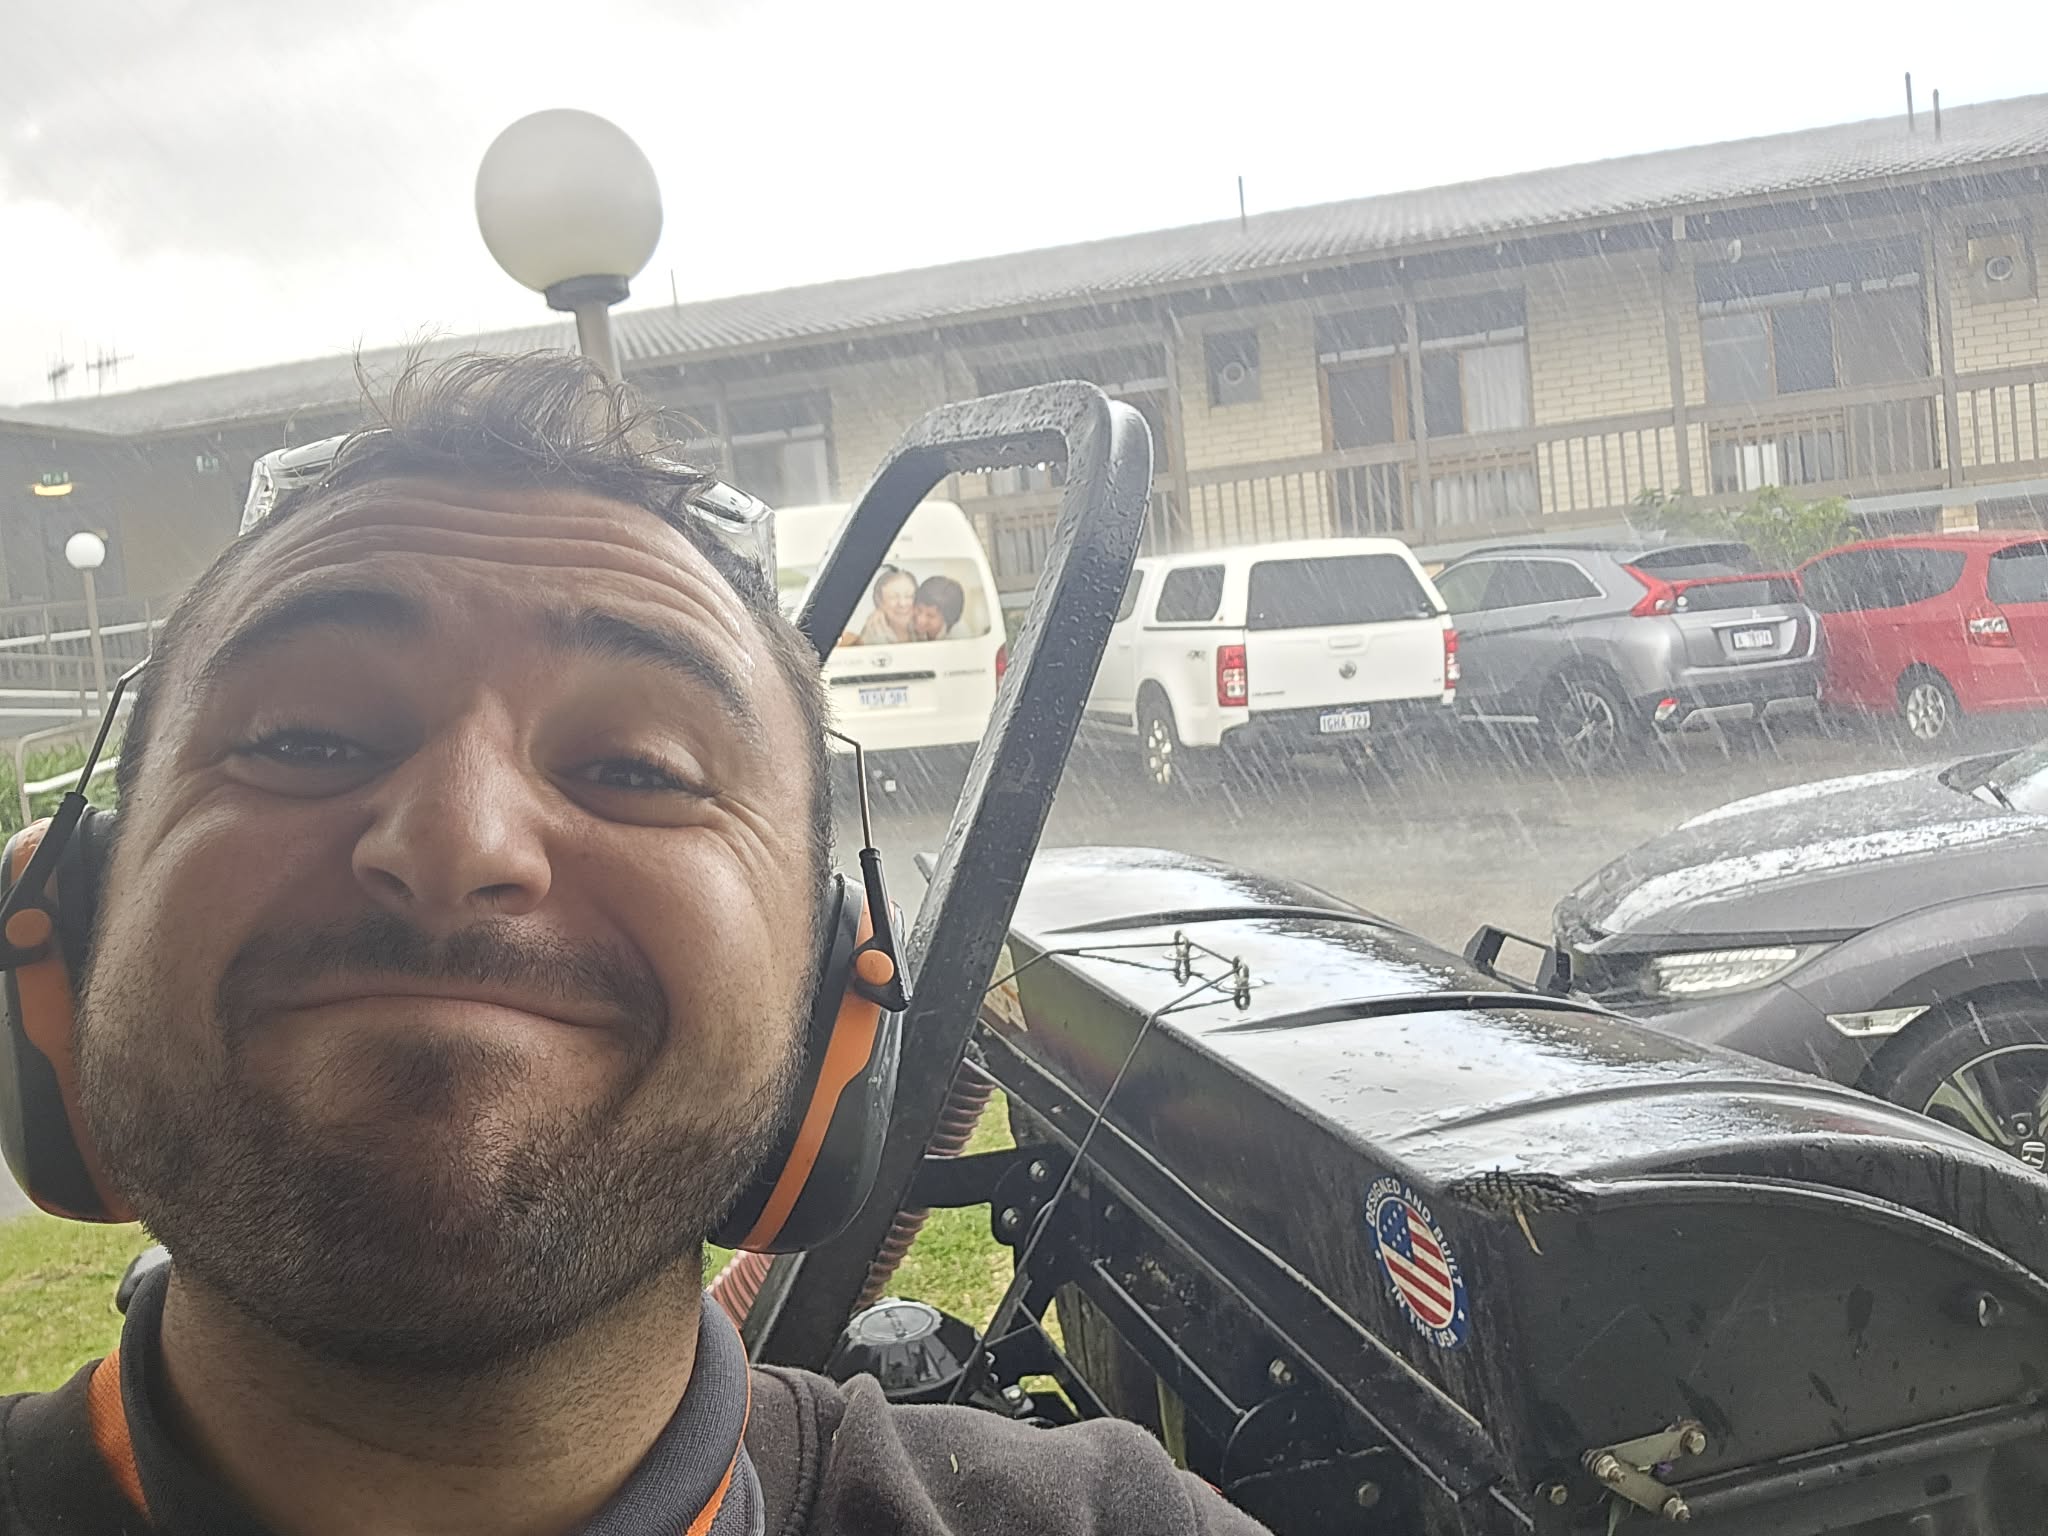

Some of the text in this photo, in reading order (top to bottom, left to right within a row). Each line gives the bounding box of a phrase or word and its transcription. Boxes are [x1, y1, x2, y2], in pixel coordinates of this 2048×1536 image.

[1366, 1177, 1463, 1288] DESIGNED AND BUILT
[1391, 1285, 1458, 1347] IN THE USA
